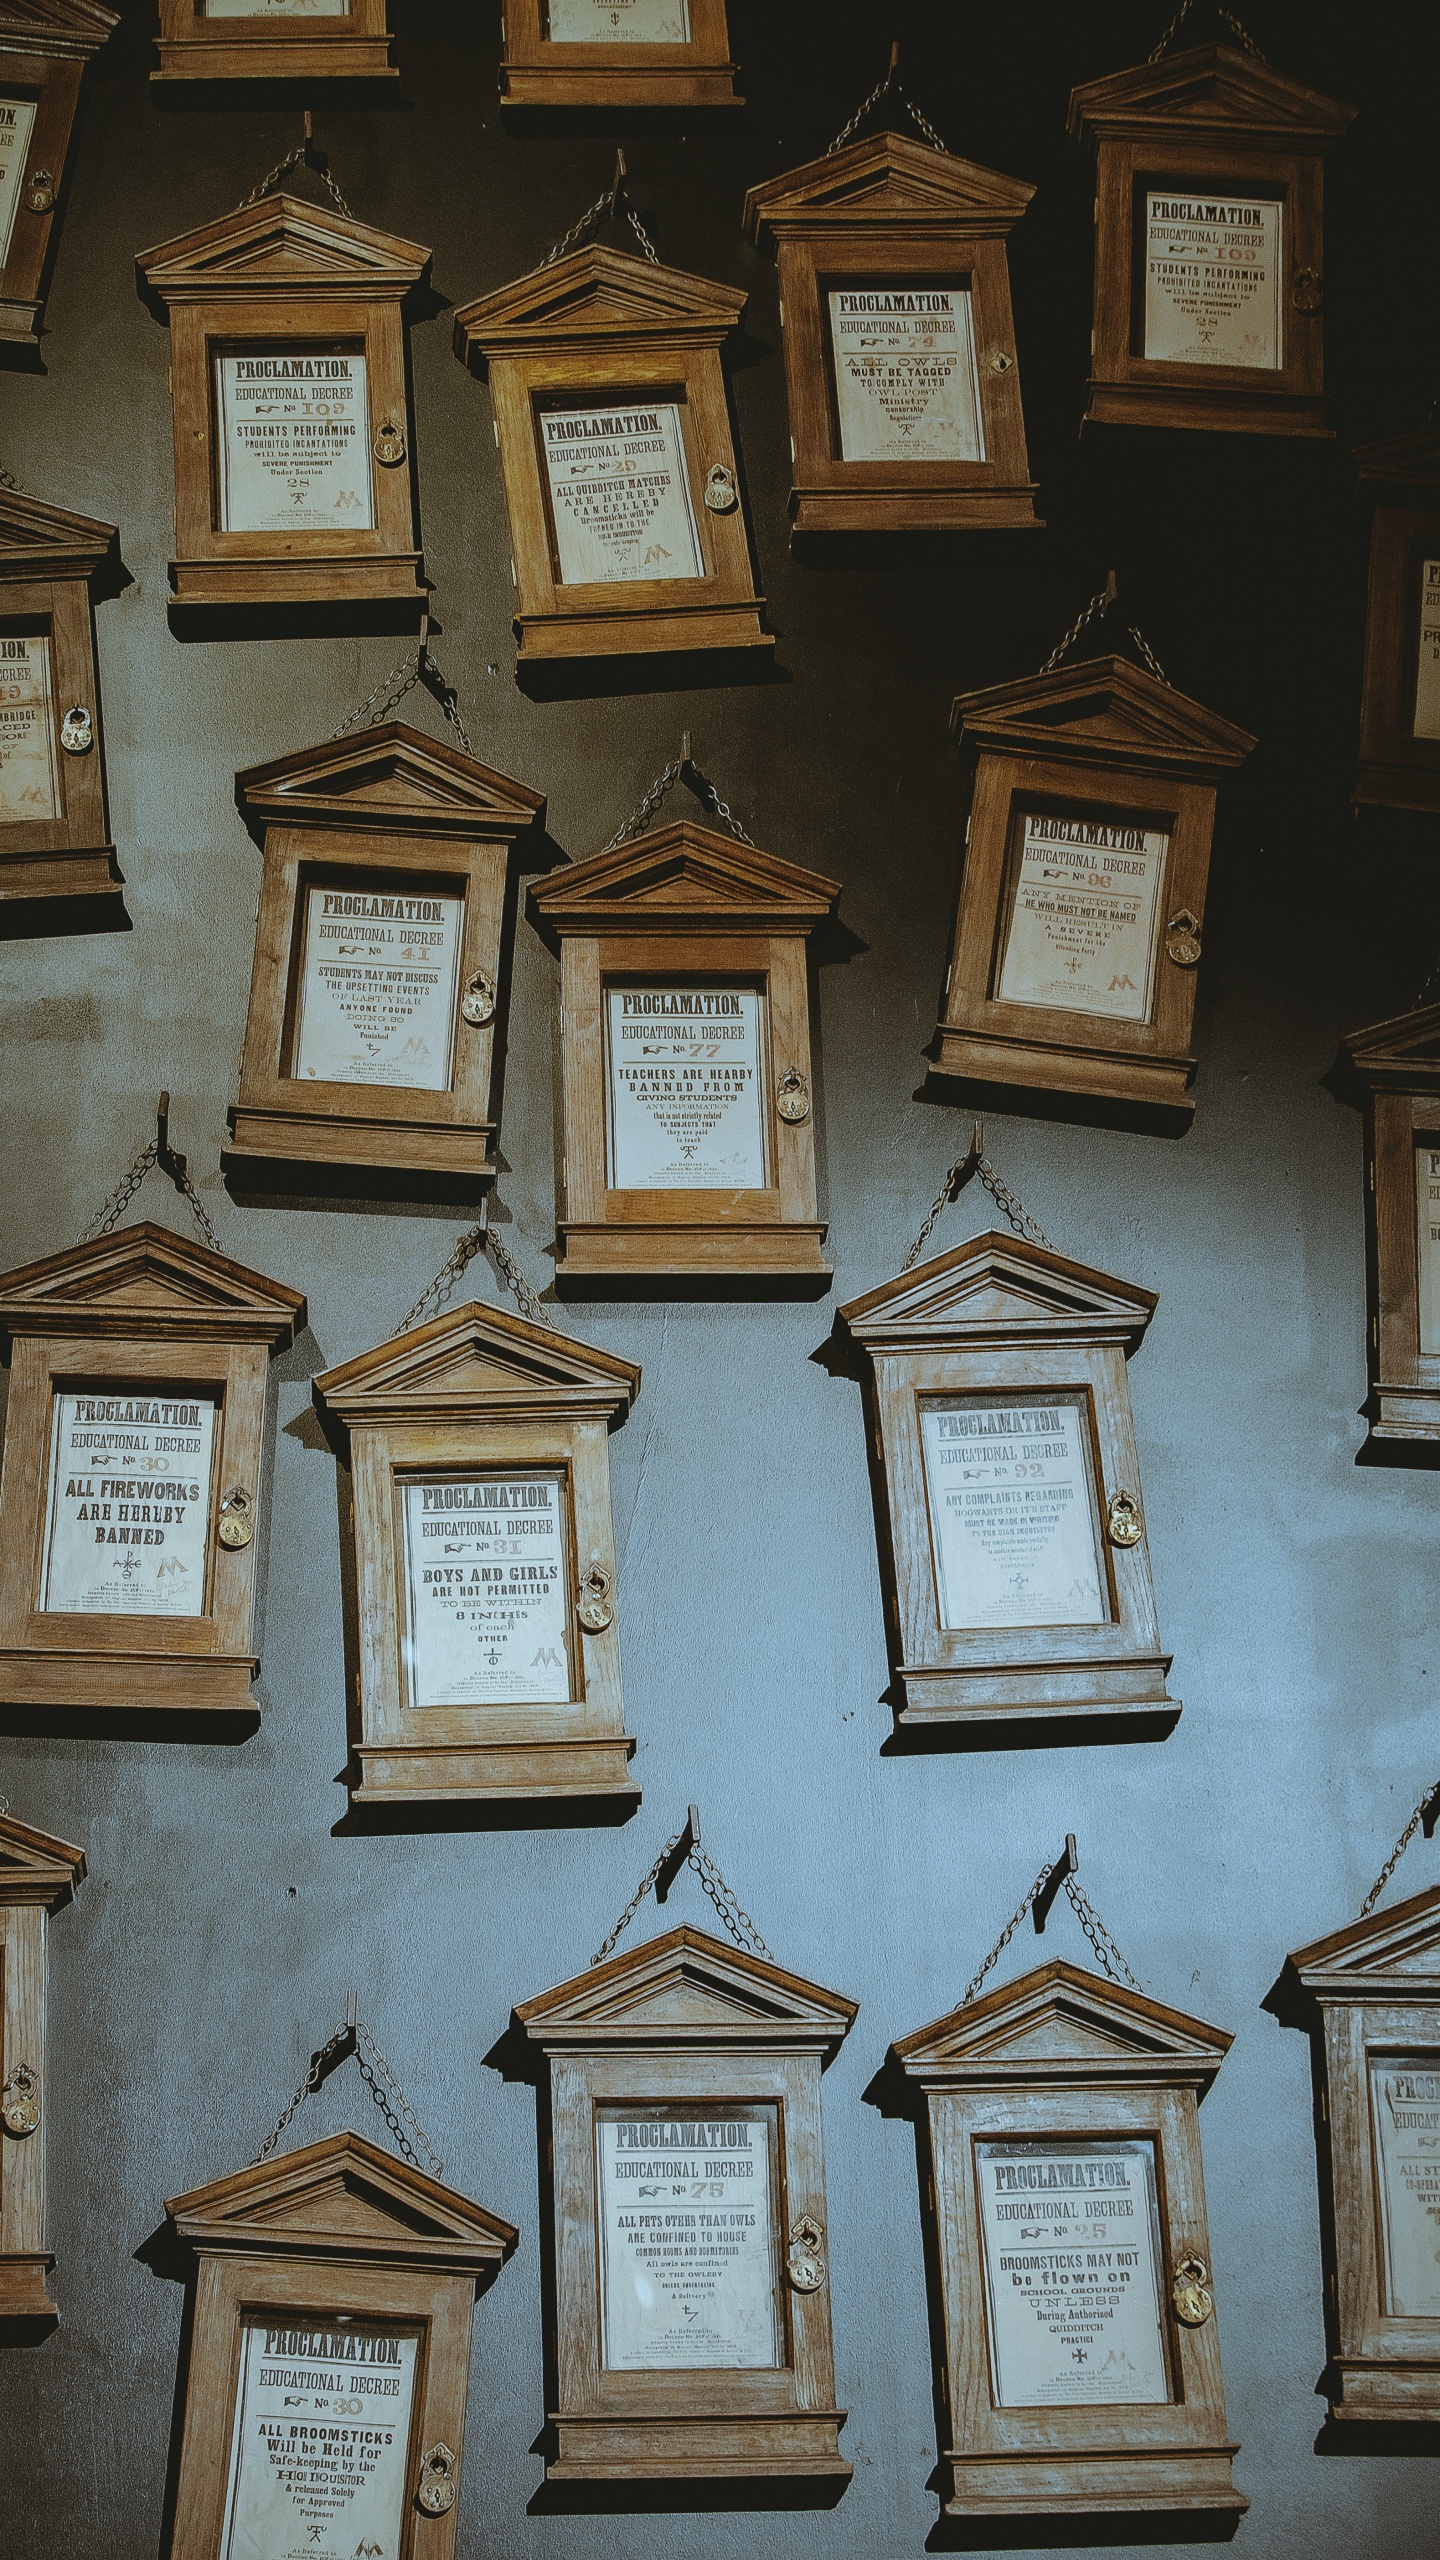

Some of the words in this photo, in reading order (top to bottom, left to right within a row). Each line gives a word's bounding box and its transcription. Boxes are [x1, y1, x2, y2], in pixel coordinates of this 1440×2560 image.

[1152, 201, 1264, 226] PROCLAMATION.
[1150, 227, 1219, 244] EDUCATIONAL
[1224, 233, 1264, 248] DECREE
[1150, 264, 1198, 275] STUDENTS
[1205, 268, 1265, 281] PERFORMING
[840, 295, 953, 311] PROCLAMATION.
[840, 322, 909, 333] EDUCATIONAL
[915, 321, 955, 333] DECREE
[236, 360, 352, 378] PROCLAMATION.
[845, 358, 887, 366] ALL
[898, 358, 957, 366] OWLS
[852, 368, 882, 376] MUST
[889, 368, 901, 376] BE
[909, 368, 951, 376] TAGGED
[860, 379, 872, 387] TO
[876, 379, 913, 387] COMPLY
[235, 388, 306, 400] EDUCATIONAL
[312, 388, 353, 399] DECREE
[302, 403, 345, 415] 109
[237, 426, 287, 436] STUDENTS
[294, 426, 355, 436] PERFORMING
[546, 414, 662, 440] PROCLAMATION.
[245, 440, 289, 448] PROHIBITED
[293, 439, 348, 448] INCANTATIONS
[549, 445, 619, 462] EDUCATIONAL
[624, 440, 666, 455] DECREE
[557, 487, 574, 497] ALL
[576, 481, 624, 495] QUIDDITCH
[628, 476, 671, 488] MATCHES
[565, 497, 593, 507] ARE
[603, 488, 667, 502] HEREBY
[573, 499, 659, 516] CANCELLED
[1029, 818, 1147, 852] PROCLAMATION.
[1024, 848, 1098, 869] EDUCATIONAL
[1103, 858, 1146, 876] DECREE
[1021, 889, 1050, 898] ANY
[1056, 894, 1119, 908] MENTION
[323, 895, 445, 922] PROCLAMATION.
[1026, 899, 1035, 907] HE
[1038, 901, 1055, 911] WHO
[1058, 903, 1078, 913] MUST
[1081, 907, 1096, 916] NOT
[1098, 910, 1107, 918] BE
[1110, 911, 1136, 921] NAMED
[319, 925, 393, 943] EDUCATIONAL
[399, 931, 443, 945] DECREE
[401, 947, 430, 961] 41
[319, 967, 362, 979] STUDENTS
[365, 970, 383, 980] MAY
[386, 972, 402, 981] NOT
[405, 973, 438, 983] DISCUSS
[326, 981, 342, 990] THE
[346, 981, 393, 993] UPSETTING
[397, 986, 430, 995] EVENTS
[623, 995, 744, 1014] PROCLAMATION.
[622, 1026, 696, 1039] EDUCATIONAL
[702, 1026, 745, 1039] DECREE
[689, 1044, 721, 1057] 77
[619, 1070, 675, 1079] TEACHERS
[683, 1070, 703, 1079] ARE
[710, 1069, 753, 1079] HEARBY
[630, 1083, 693, 1092] BANNED
[704, 1082, 744, 1091] FROM
[75, 1401, 202, 1426] PROCLAMATION.
[937, 1410, 1065, 1437] PROCLAMATION.
[71, 1434, 149, 1450] EDUCATIONAL
[155, 1437, 200, 1453] DECREE
[940, 1446, 1018, 1464] EDUCATIONAL
[1023, 1443, 1068, 1459] DECREE
[140, 1457, 170, 1472] 30
[1015, 1463, 1045, 1478] 92
[65, 1479, 95, 1497] ALL
[101, 1481, 200, 1500] FIREWORKS
[422, 1487, 552, 1509] PROCLAMATION.
[946, 1495, 963, 1506] ANY
[966, 1492, 1021, 1505] COMPLAINTS
[1025, 1489, 1074, 1501] REGARDING
[77, 1505, 111, 1520] ARE
[118, 1505, 186, 1523] HEREBY
[95, 1527, 165, 1545] BANNED
[422, 1520, 501, 1537] EDUCATIONAL
[507, 1520, 553, 1535] DECREE
[493, 1540, 521, 1554] 31
[423, 1569, 464, 1583] BOYS
[471, 1568, 503, 1581] AND
[510, 1566, 557, 1580] GIRLS
[433, 1586, 452, 1597] ARE
[460, 1586, 480, 1596] NOT
[487, 1584, 550, 1595] PERMITTED
[456, 1612, 464, 1620] 8
[470, 1611, 528, 1620] INCHES
[1394, 2112, 1440, 2129] EDUCAT
[617, 2124, 753, 2148] PROCLAMATION.
[615, 2162, 698, 2178] EDUCATIONAL
[705, 2162, 753, 2177] DECREE
[995, 2162, 1131, 2190] PROCLAMATION.
[1400, 2165, 1420, 2175] ALL
[690, 2183, 724, 2198] 75
[1406, 2179, 1440, 2190] CO-OPERA
[996, 2202, 1079, 2221] EDUCATIONAL
[1085, 2200, 1134, 2218] DECREE
[618, 2216, 636, 2227] ALL
[640, 2216, 663, 2227] PETS
[665, 2215, 696, 2227] OTHER
[699, 2215, 727, 2226] THAN
[730, 2214, 756, 2226] OWLS
[628, 2233, 645, 2243] ARE
[650, 2232, 696, 2243] CONFINED
[701, 2232, 712, 2242] TO
[717, 2231, 746, 2242] HOUSE
[1000, 2255, 1082, 2270] BROOMSTICKS
[1087, 2253, 1112, 2267] MAY
[1117, 2252, 1139, 2266] NOT
[1012, 2273, 1031, 2286] be
[1042, 2273, 1099, 2285] flown
[1108, 2272, 1130, 2282] on
[1071, 2286, 1125, 2294] GROUNDS
[1028, 2296, 1120, 2308] UNLESS
[1037, 2311, 1065, 2322] During
[1068, 2309, 1113, 2320] Authorised
[264, 2331, 402, 2365] PROCLAMATION.
[259, 2369, 344, 2392] EDUCATIONAL
[350, 2376, 399, 2396] DECREE
[333, 2398, 363, 2415] 30
[258, 2424, 282, 2437] ALL
[290, 2426, 393, 2445] BROOMSTICKS
[267, 2439, 295, 2452] Will
[302, 2442, 316, 2455] be
[323, 2443, 353, 2457] Held
[360, 2445, 381, 2460] for
[269, 2454, 338, 2471] Safe-keeping
[342, 2459, 355, 2472] by
[359, 2461, 375, 2472] the
[276, 2470, 307, 2481] HIGH
[310, 2473, 366, 2486] INQUISITOR
[285, 2484, 292, 2492] &
[295, 2485, 328, 2495] released
[331, 2487, 355, 2498] Solely
